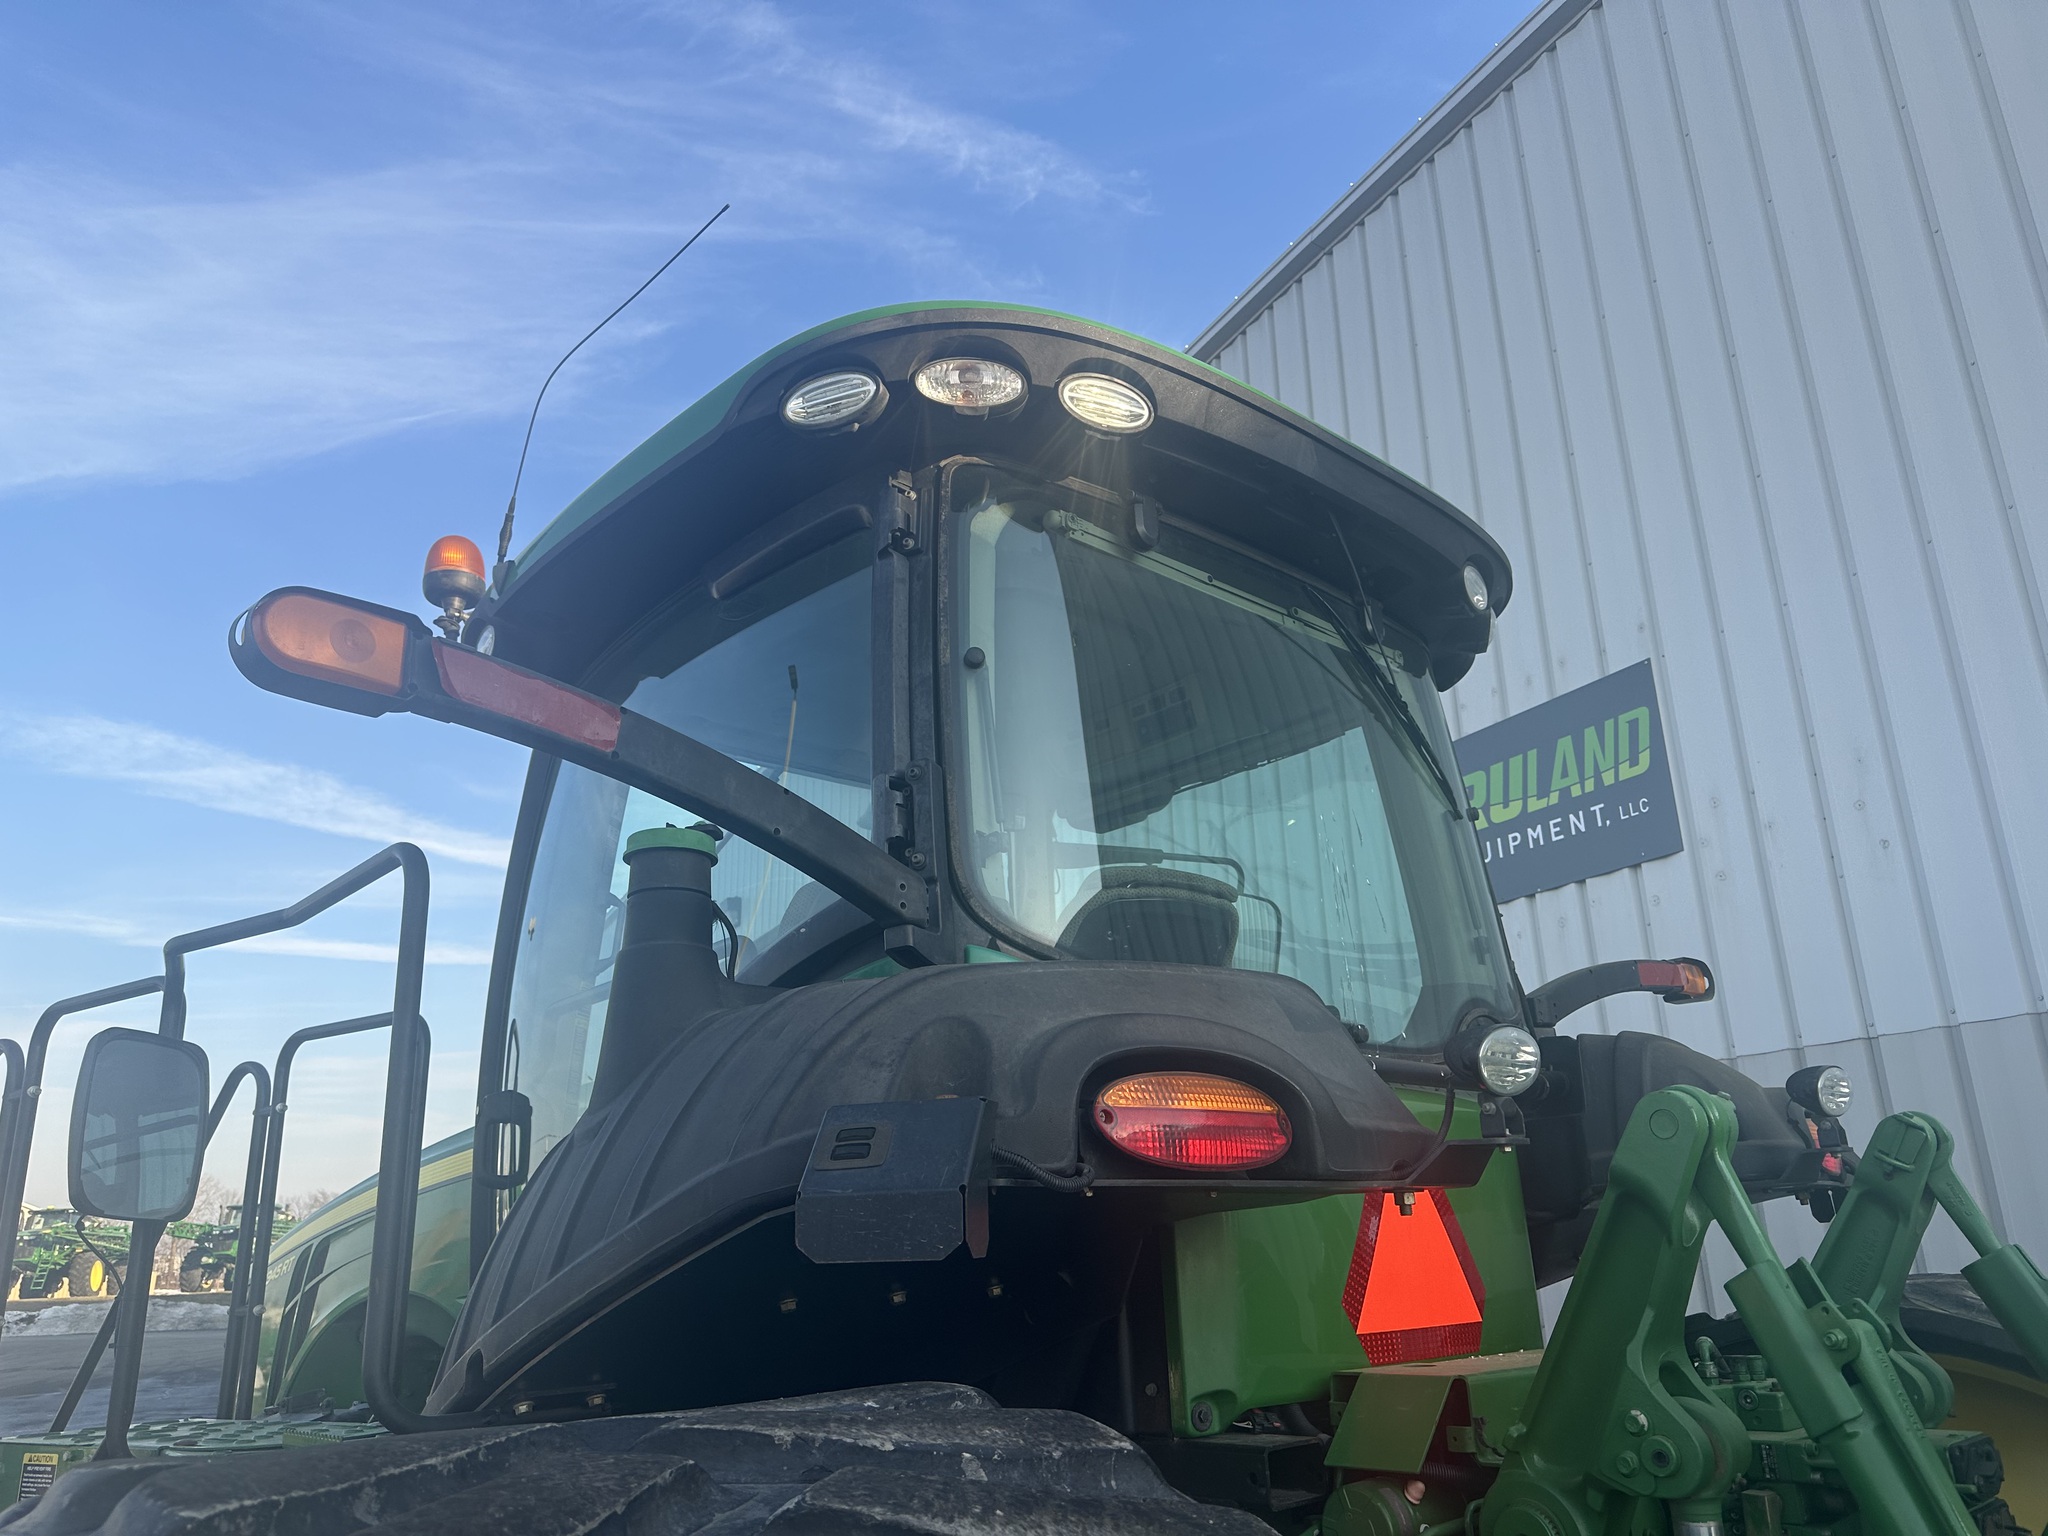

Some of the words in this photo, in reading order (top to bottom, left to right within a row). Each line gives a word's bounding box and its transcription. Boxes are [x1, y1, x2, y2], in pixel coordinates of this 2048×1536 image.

[1463, 706, 1650, 830] RULAND
[1618, 798, 1650, 820] LLC
[33, 1455, 54, 1463] CAUTION
